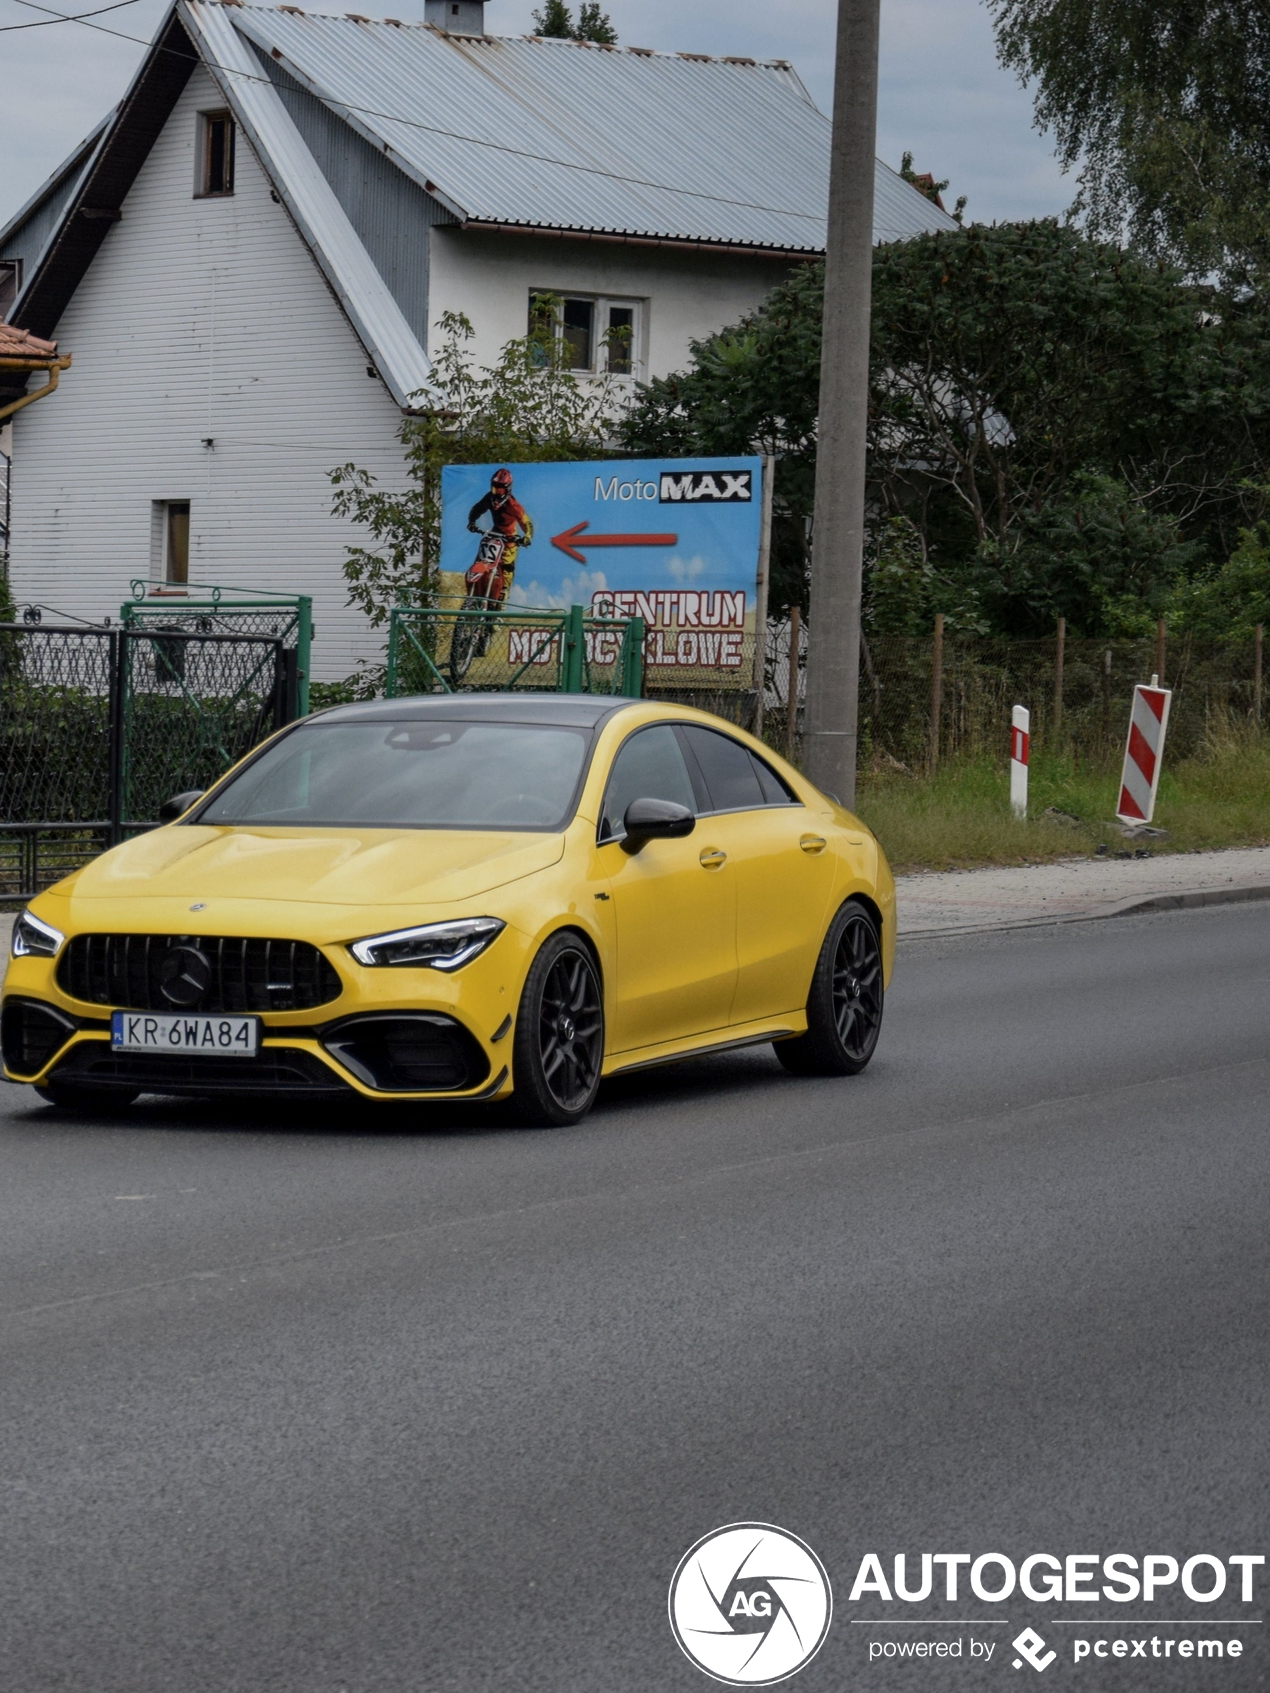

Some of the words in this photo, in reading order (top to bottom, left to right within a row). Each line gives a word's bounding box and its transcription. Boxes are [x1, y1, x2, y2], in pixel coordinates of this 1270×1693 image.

[592, 590, 746, 627] CENTRUM
[114, 1032, 123, 1041] PL
[128, 1017, 158, 1045] KR
[168, 1019, 249, 1048] 6WA84
